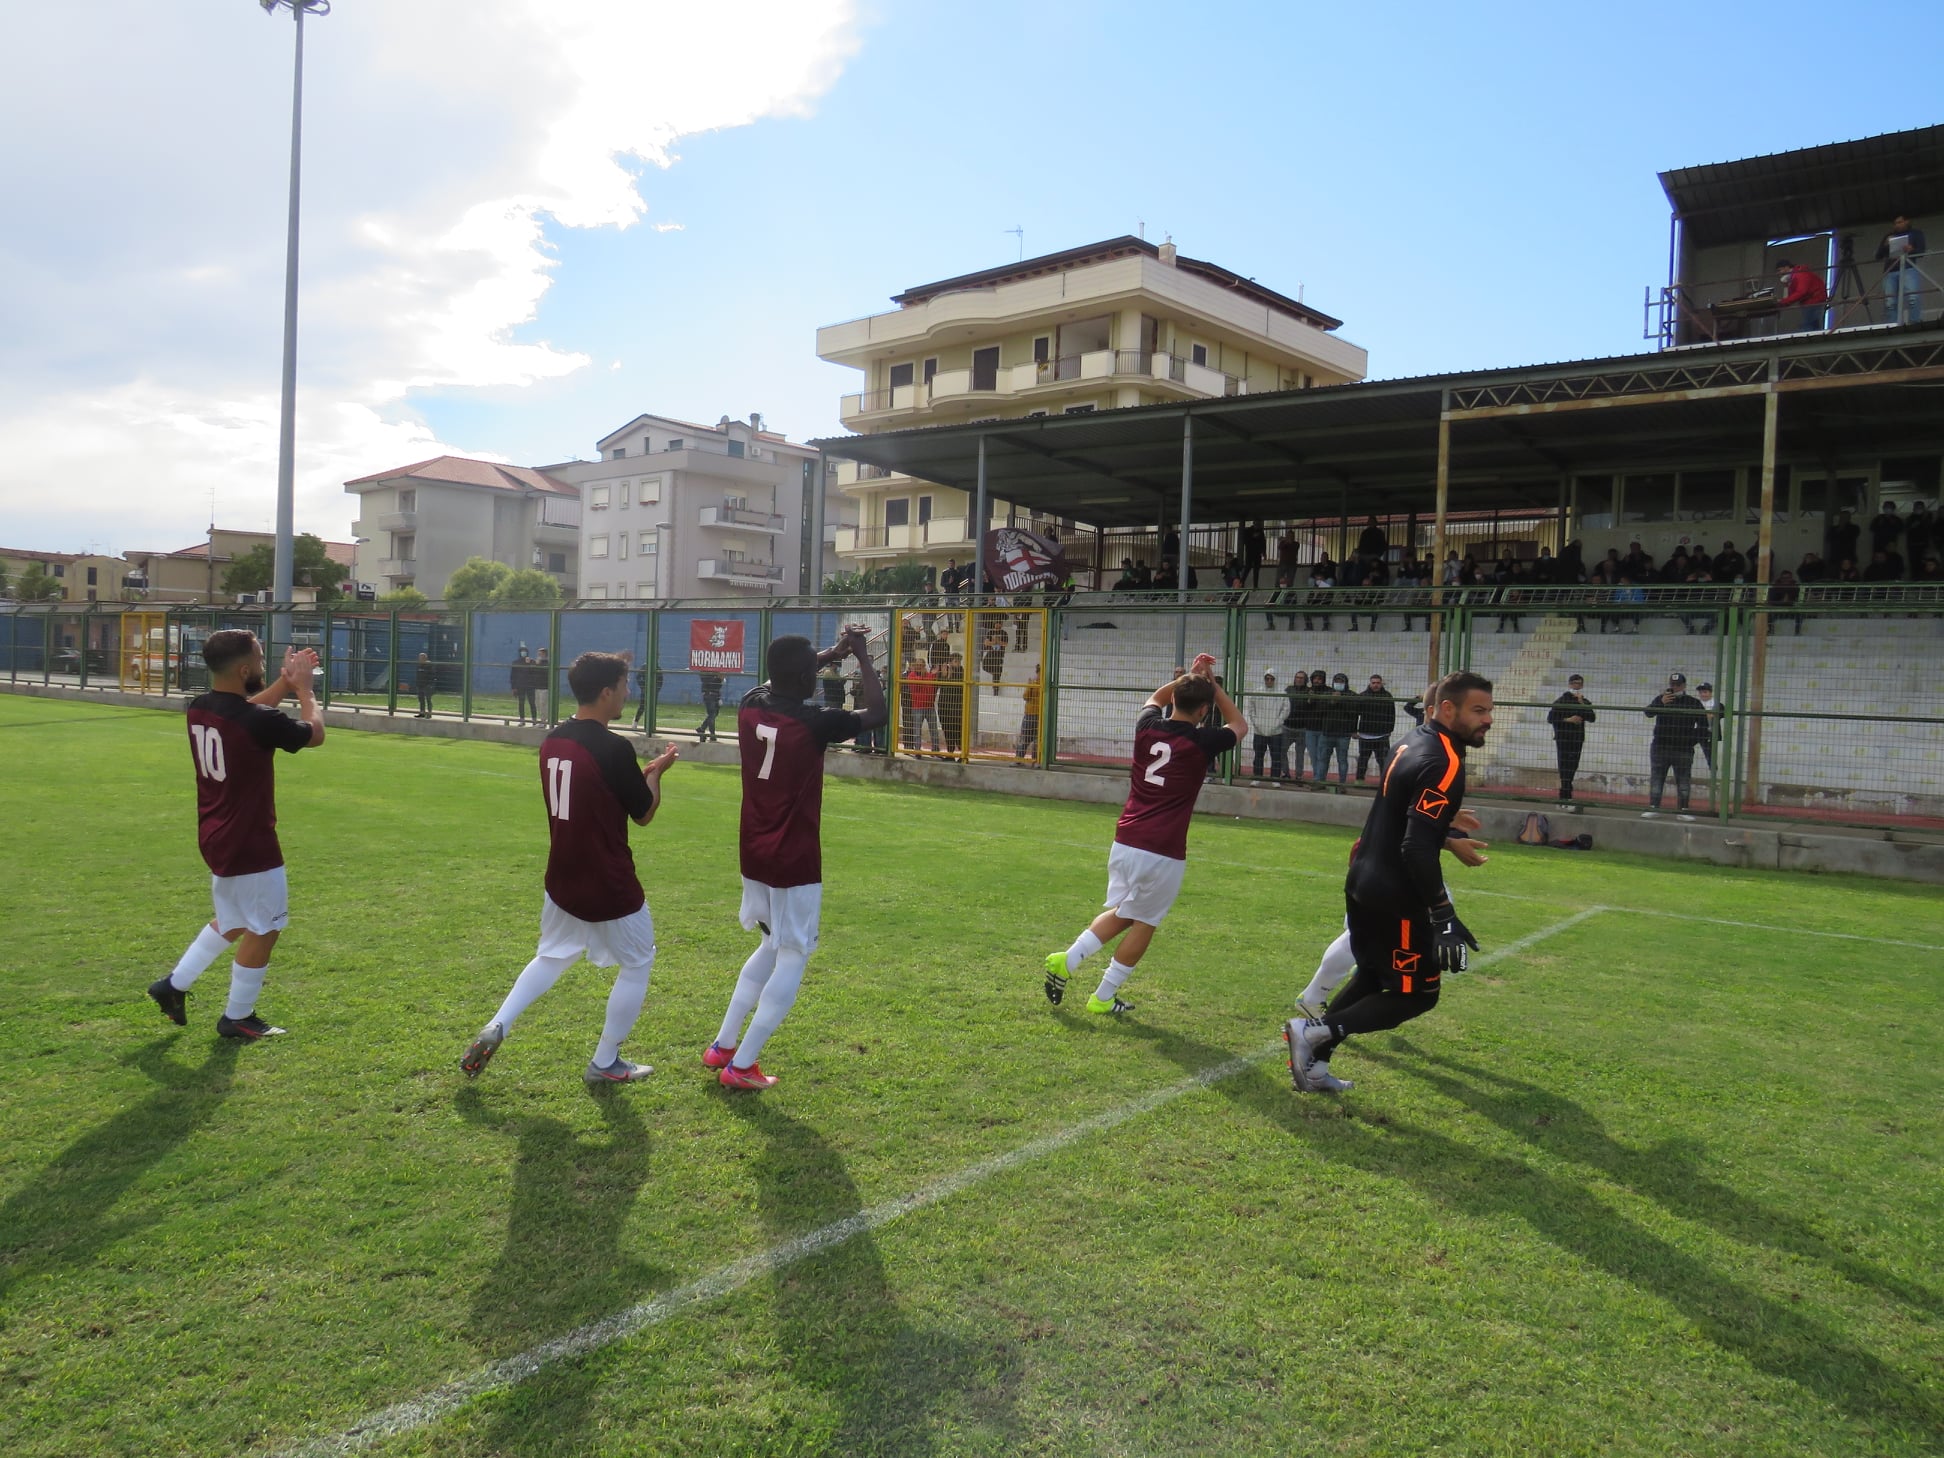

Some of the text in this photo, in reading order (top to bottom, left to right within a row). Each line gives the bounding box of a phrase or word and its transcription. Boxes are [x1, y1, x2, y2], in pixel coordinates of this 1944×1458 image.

[691, 649, 741, 669] NORMANNI
[191, 724, 227, 783] 10
[755, 723, 778, 780] 7
[1144, 741, 1172, 787] 2
[1382, 744, 1408, 797] 1
[547, 757, 572, 821] 11
